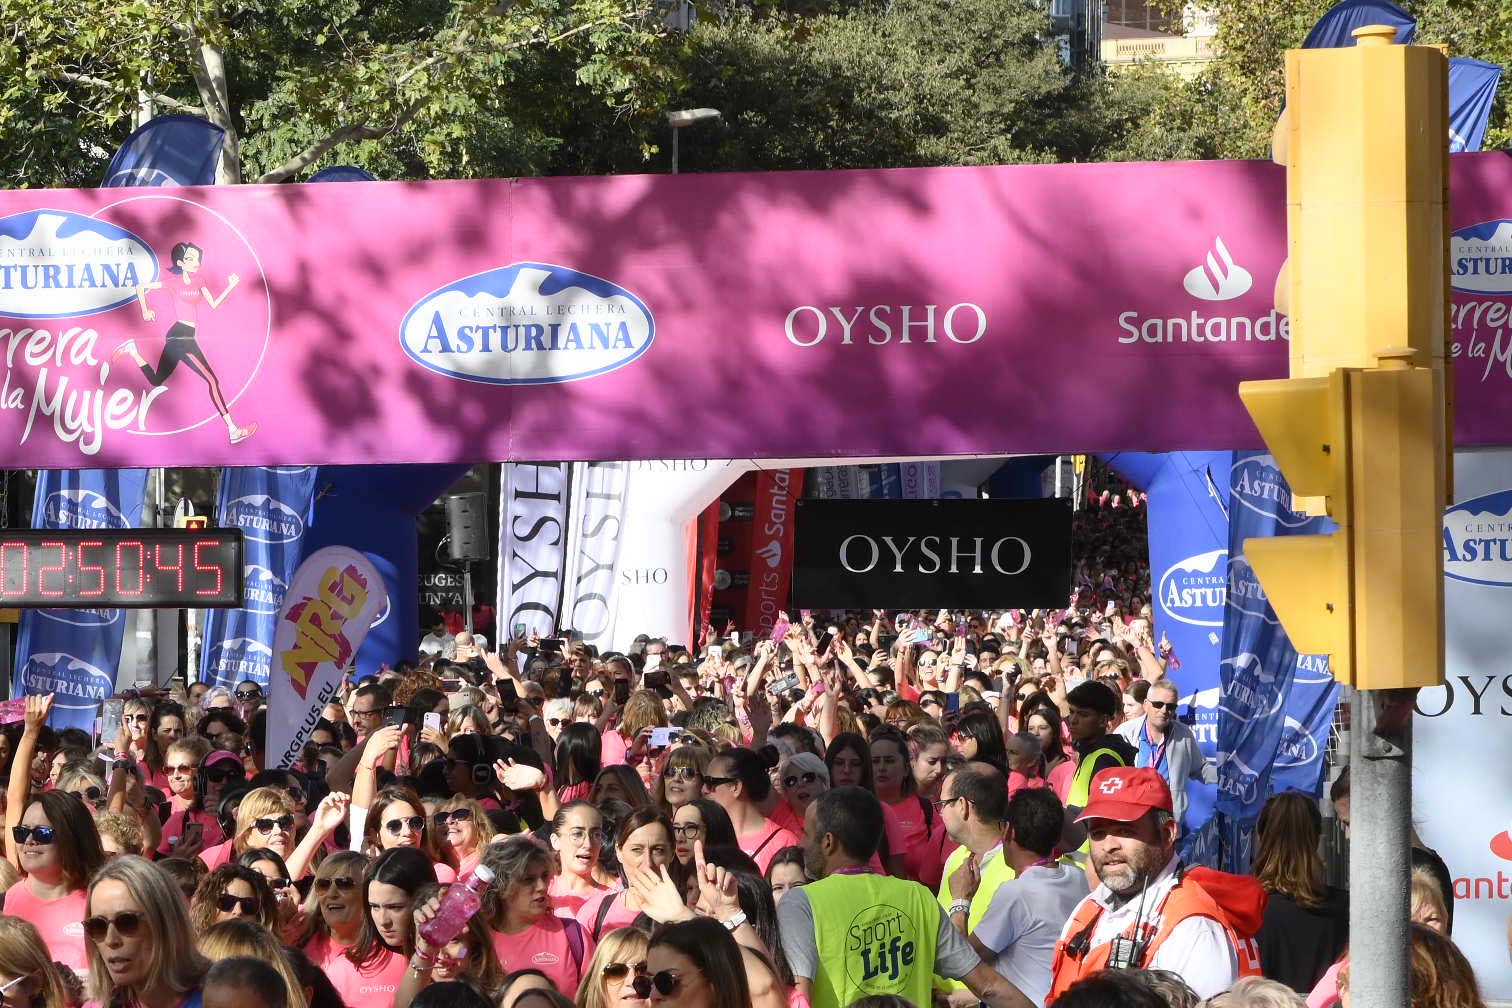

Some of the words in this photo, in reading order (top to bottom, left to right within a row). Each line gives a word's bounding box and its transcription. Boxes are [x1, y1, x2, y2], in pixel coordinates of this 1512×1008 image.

[459, 304, 537, 317] CENTRAL
[545, 303, 627, 315] LECHERA
[784, 302, 988, 347] OYSHO
[1117, 310, 1290, 343] Santande
[419, 310, 635, 355] ASTURIANA
[1468, 339, 1486, 358] la
[0, 370, 25, 410] la
[19, 362, 169, 456] Mujer
[227, 506, 297, 537] ASTURIANA
[0, 540, 221, 596] 02:50:45
[839, 534, 1032, 575] OYSHO
[1166, 579, 1226, 608] ASTU
[1182, 577, 1225, 585] CENTRA
[850, 911, 905, 956] Sport
[861, 935, 915, 982] Life
[360, 984, 395, 994] OYSHO
